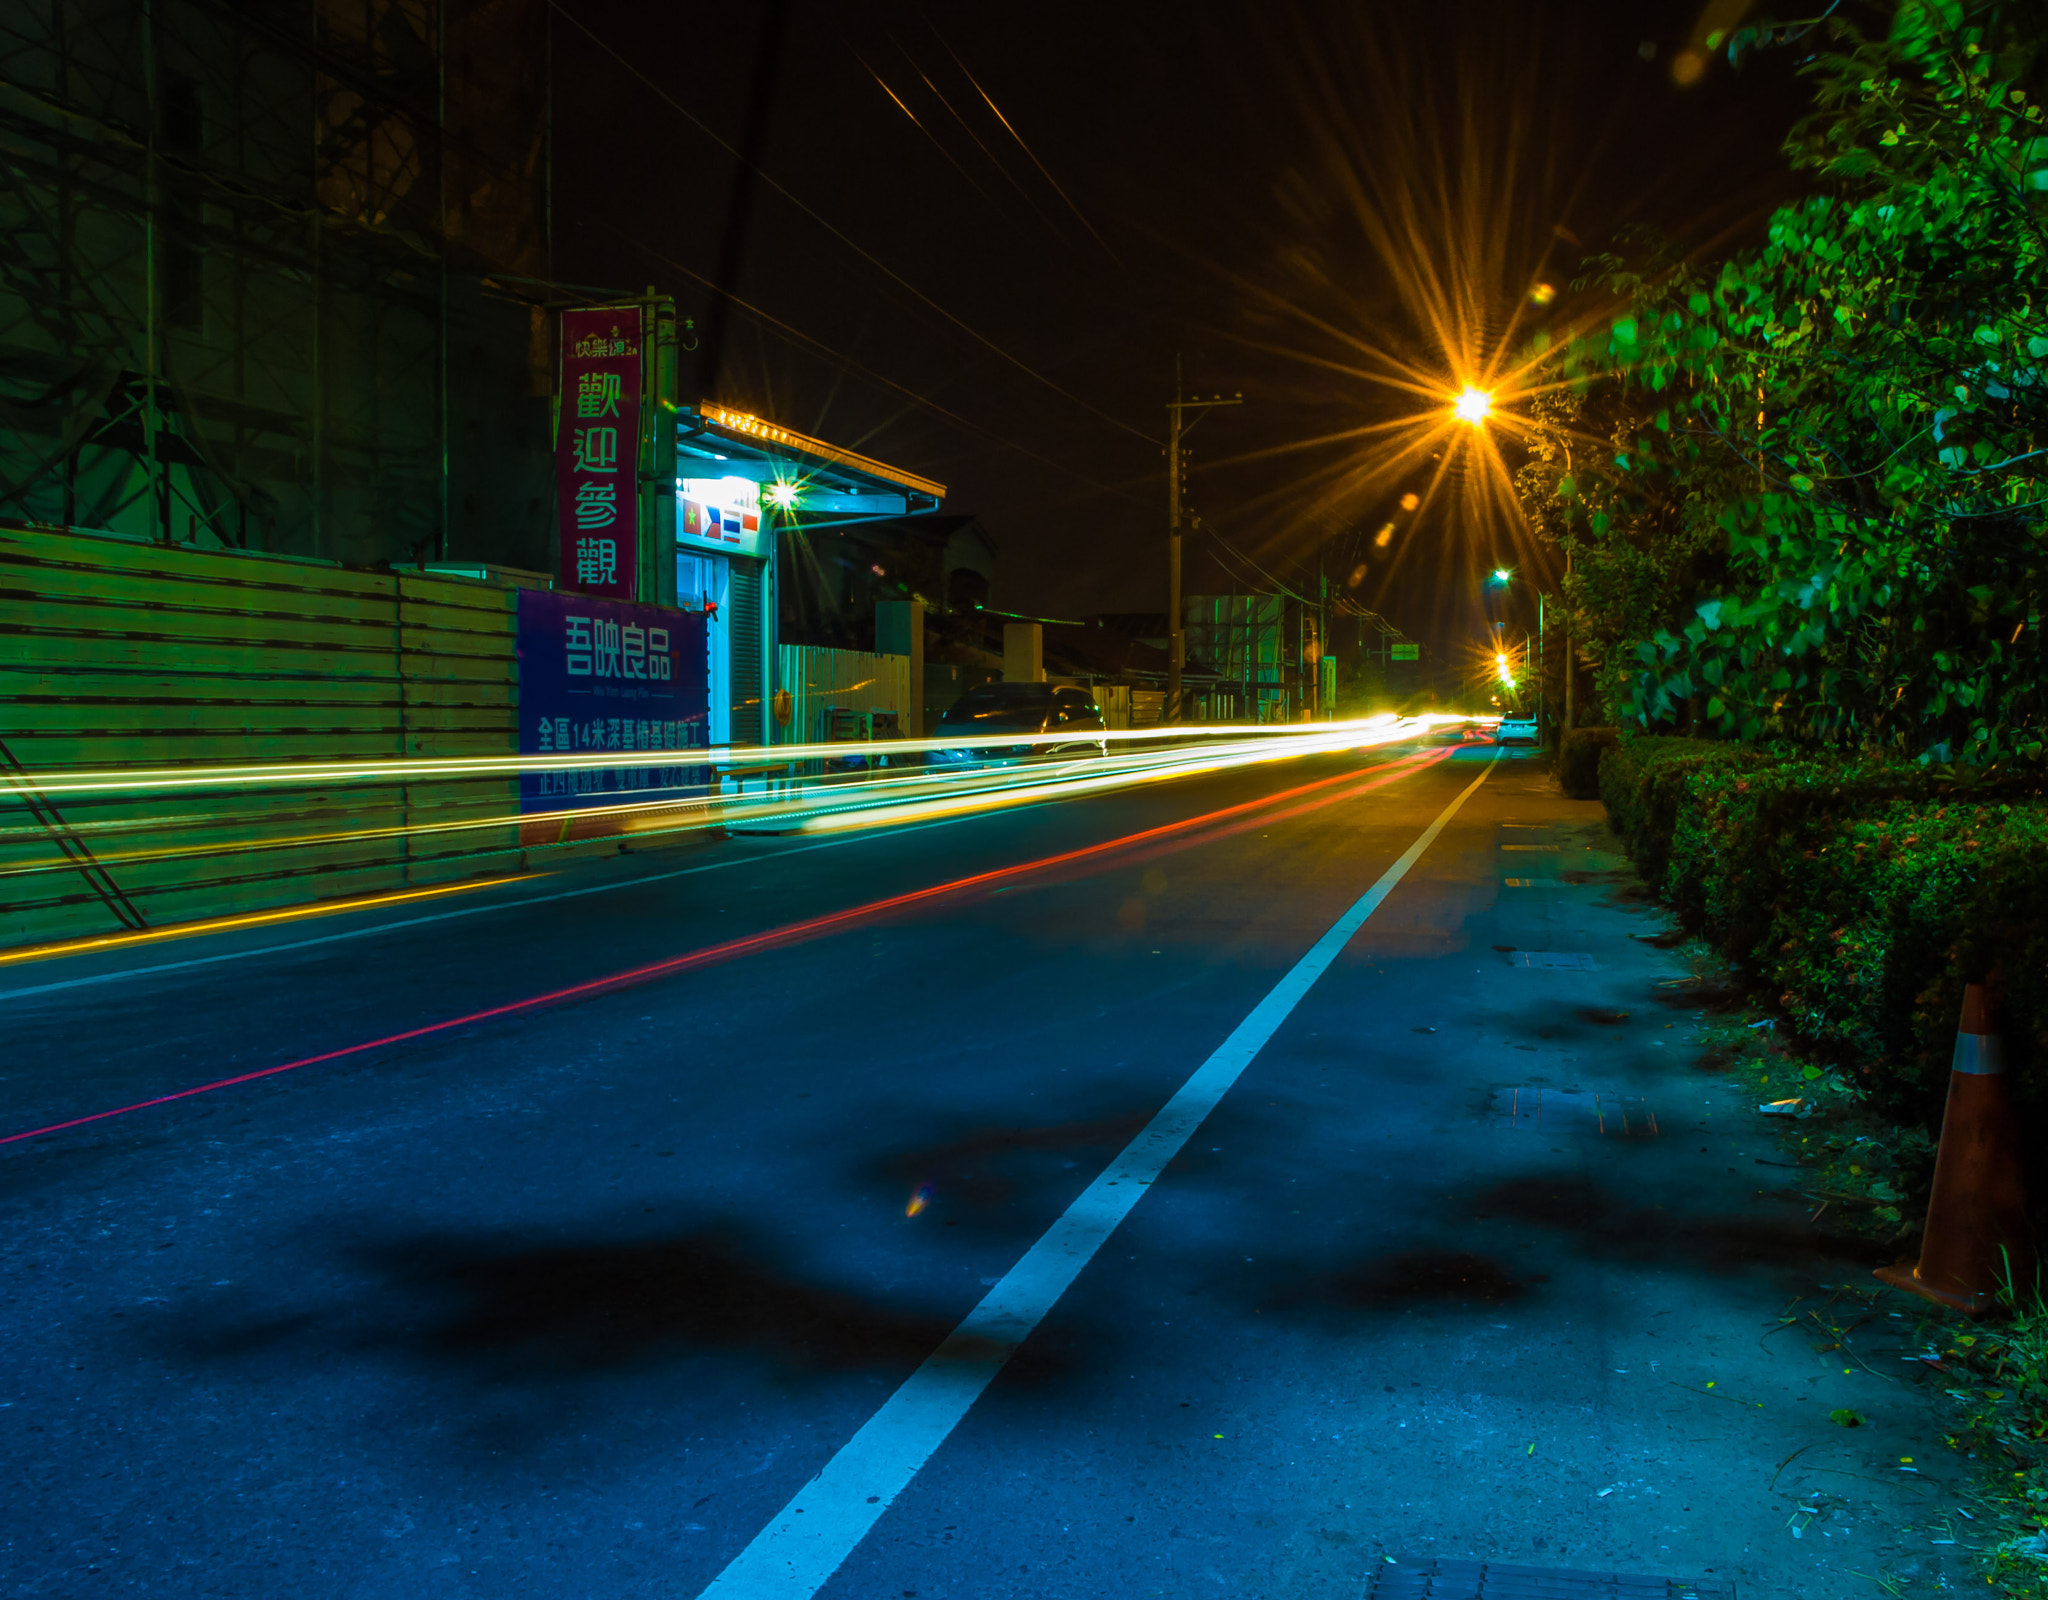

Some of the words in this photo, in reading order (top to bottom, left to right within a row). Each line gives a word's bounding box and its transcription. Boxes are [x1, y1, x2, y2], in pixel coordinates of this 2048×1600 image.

[573, 372, 621, 585] 歡迎參觀
[565, 615, 671, 681] 吾映良品
